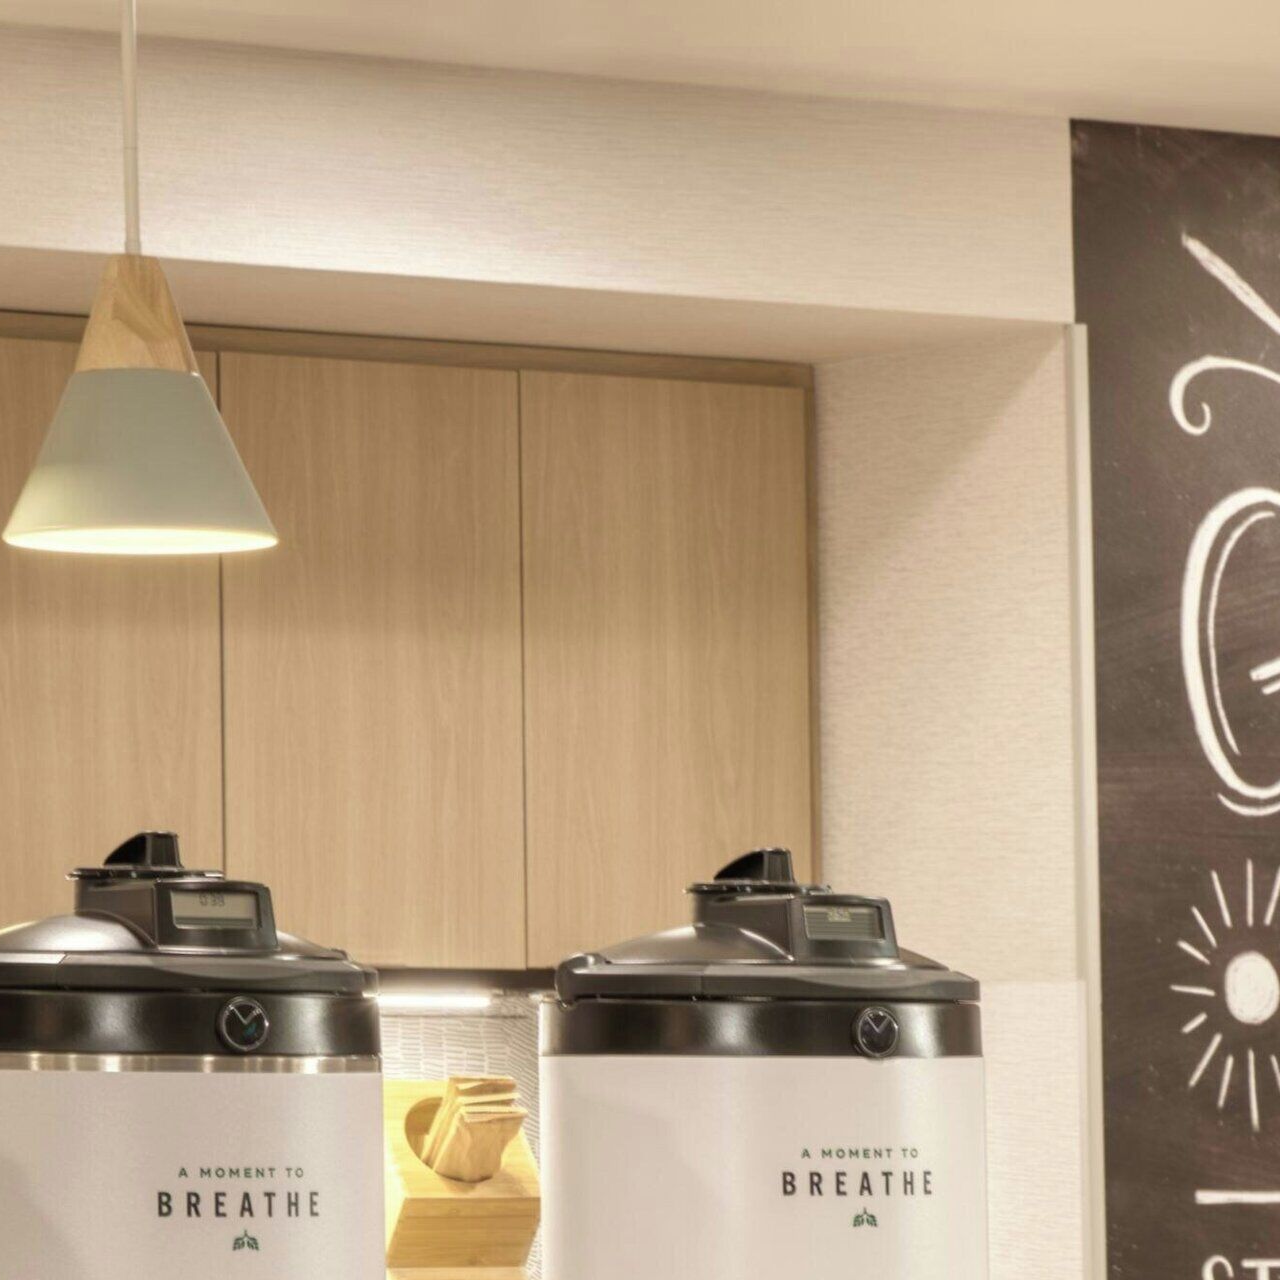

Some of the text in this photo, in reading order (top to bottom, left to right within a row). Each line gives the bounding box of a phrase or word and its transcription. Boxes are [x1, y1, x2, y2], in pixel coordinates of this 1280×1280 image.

[801, 1148, 918, 1159] A MOMENT TO
[178, 1167, 304, 1179] A MOMENT TO
[782, 1170, 932, 1197] BREATHE
[157, 1191, 320, 1218] BREATHE
